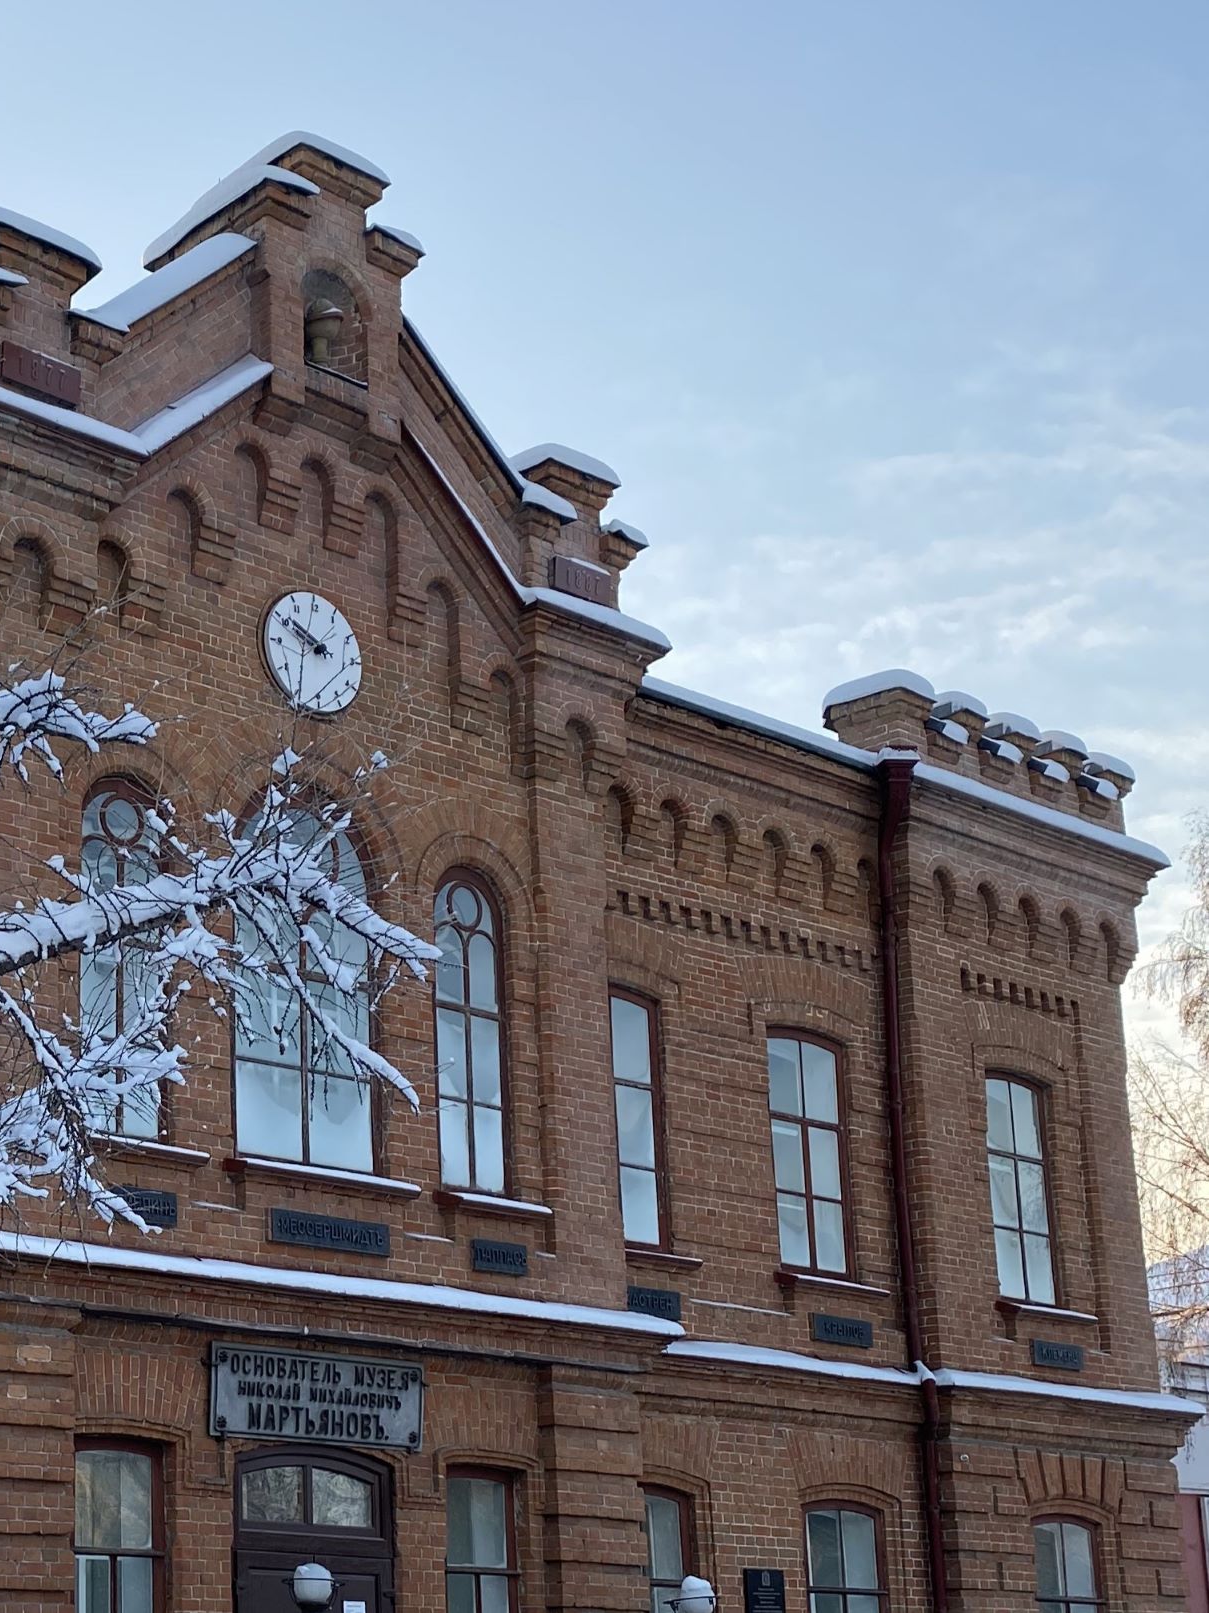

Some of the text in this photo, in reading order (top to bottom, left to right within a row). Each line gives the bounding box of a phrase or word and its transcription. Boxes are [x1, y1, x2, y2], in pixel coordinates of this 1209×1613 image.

[18, 355, 67, 392] 1877
[293, 604, 300, 614] 11
[281, 617, 290, 627] 10
[331, 615, 335, 624] 1
[277, 636, 283, 645] 9
[230, 1354, 409, 1391] ОСНОВАТЕЛЬ МУЗЕЯ
[238, 1380, 402, 1411] НИКОЛАЙ МИХАЙЛОВИЧЪ
[248, 1402, 390, 1441] МАРТЬЯНОВЪ.
